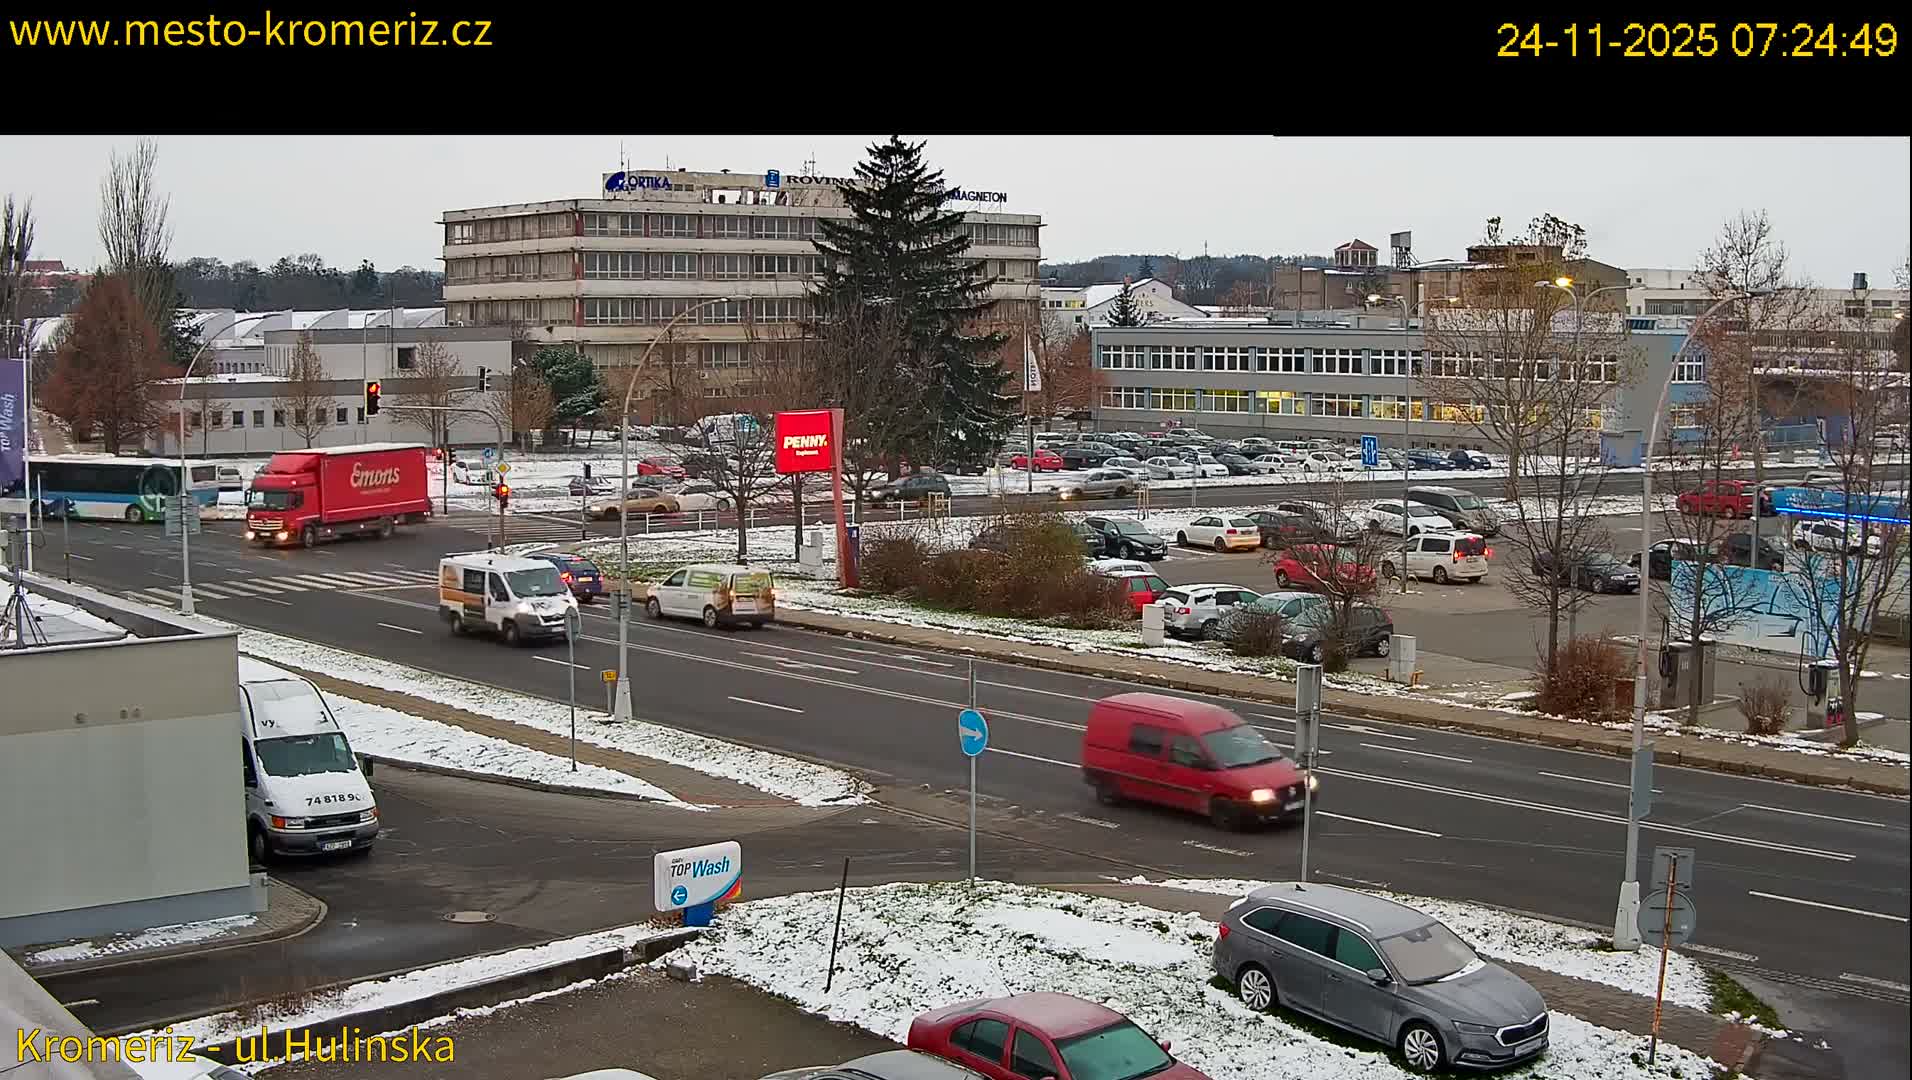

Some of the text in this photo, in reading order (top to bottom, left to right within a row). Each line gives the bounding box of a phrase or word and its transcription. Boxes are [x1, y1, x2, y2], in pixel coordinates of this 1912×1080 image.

[628, 175, 671, 189] ORTIKA
[786, 175, 856, 187] ROVINA
[953, 190, 1008, 204] MAGNETON
[350, 462, 400, 488] Emons
[305, 796, 322, 807] 74
[323, 793, 346, 804] 818
[671, 856, 730, 878] TOP Wash
